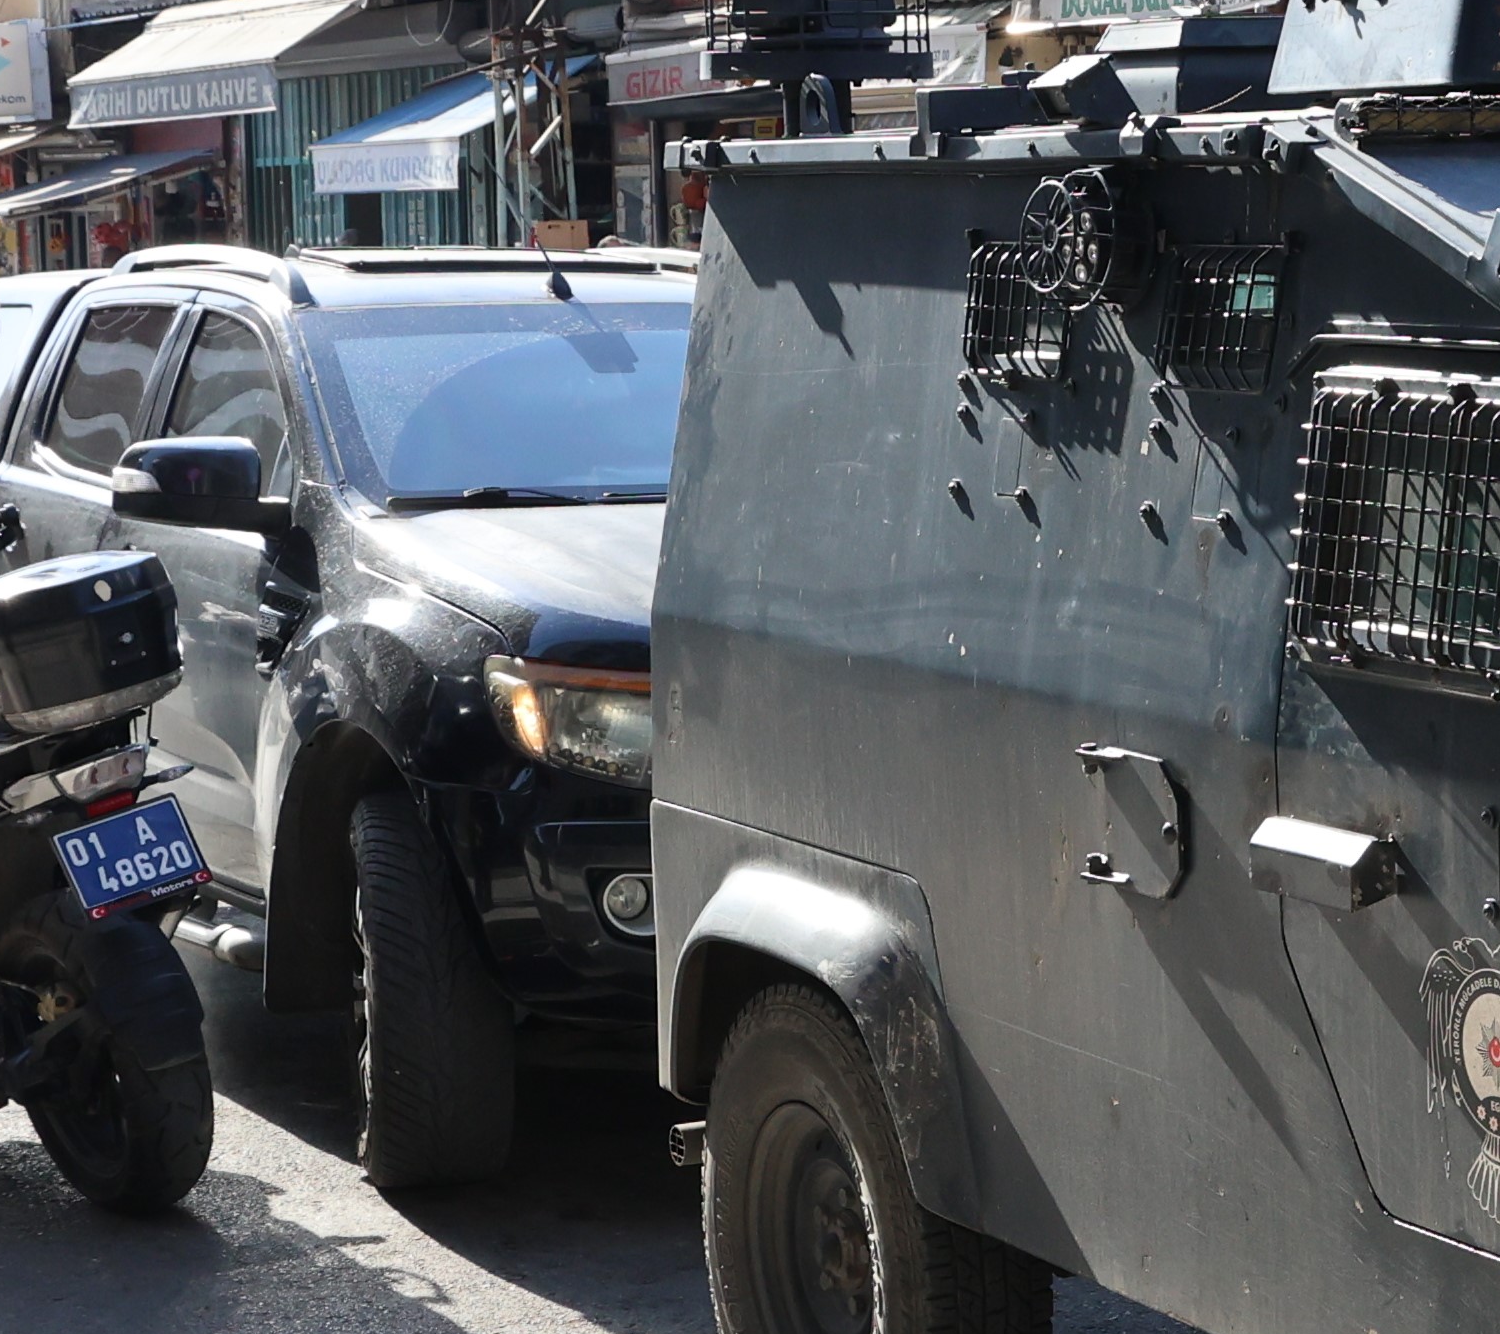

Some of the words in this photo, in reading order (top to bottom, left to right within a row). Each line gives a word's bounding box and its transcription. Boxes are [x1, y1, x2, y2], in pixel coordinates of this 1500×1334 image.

[137, 85, 190, 114] DUTLU
[197, 76, 257, 108] KAHVE
[65, 831, 106, 867] 01
[135, 816, 157, 845] A
[98, 840, 193, 892] 48620
[151, 878, 194, 897] Motors
